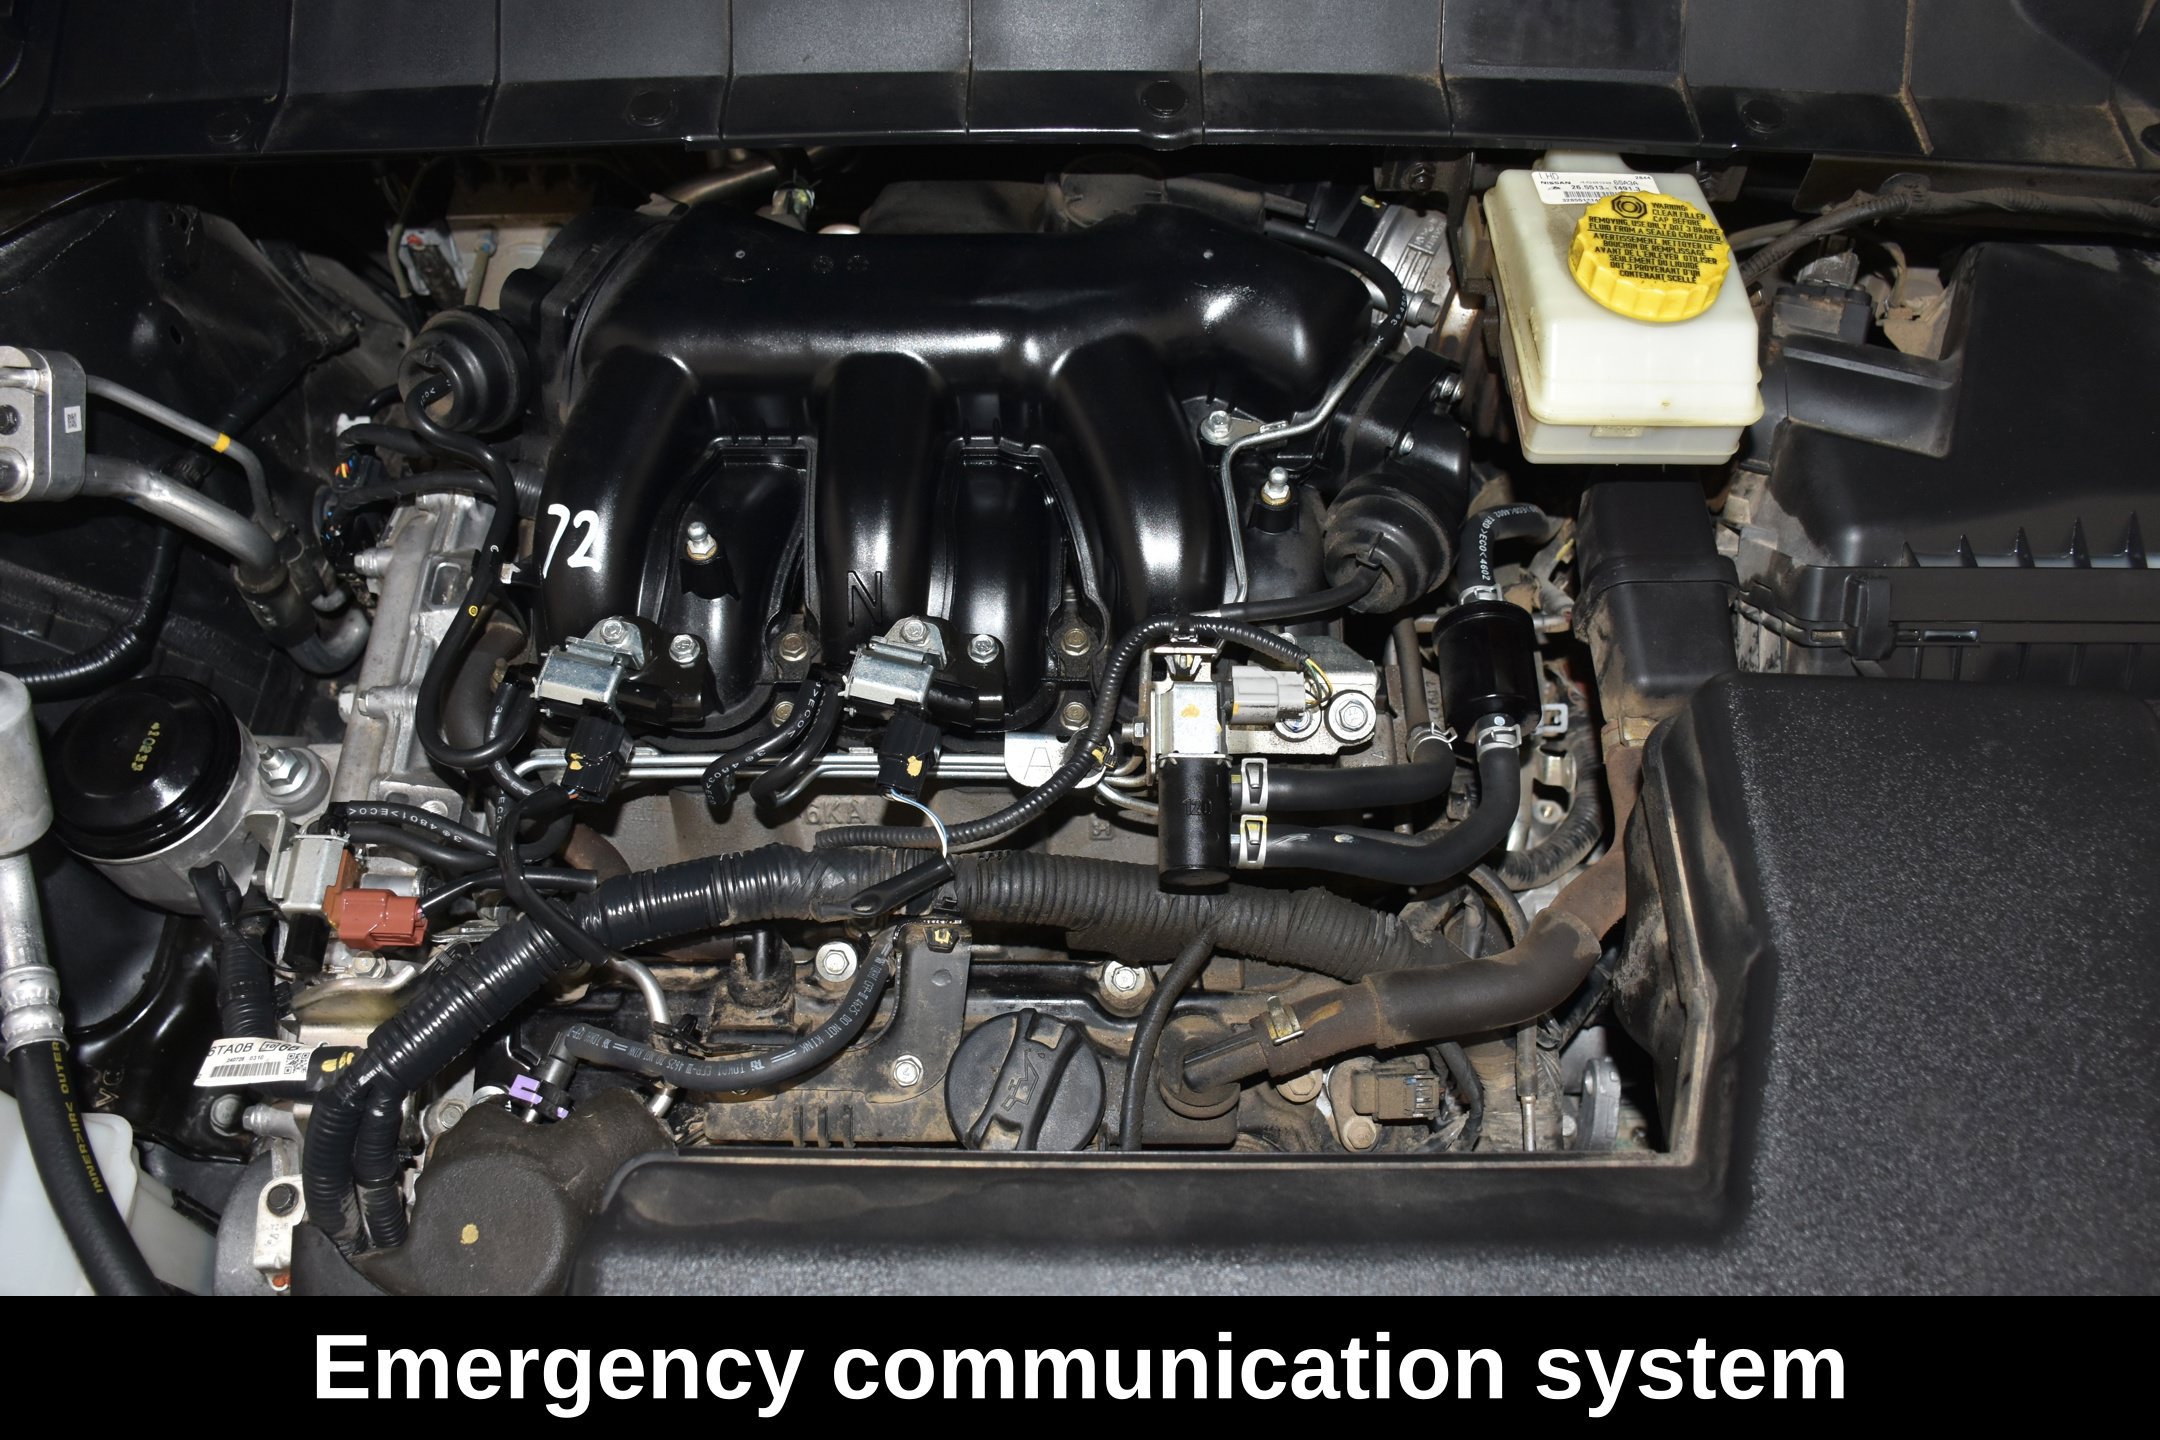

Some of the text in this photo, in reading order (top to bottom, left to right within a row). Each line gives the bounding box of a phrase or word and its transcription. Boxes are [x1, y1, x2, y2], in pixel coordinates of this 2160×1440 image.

[1651, 202, 1688, 212] WARNING:
[1652, 209, 1706, 220] CLEAN FILLER
[1647, 221, 1667, 230] ONLY
[1693, 226, 1719, 235] BRAKE
[1672, 218, 1701, 226] BEFORE
[1589, 223, 1612, 231] FLUID
[1614, 225, 1636, 233] FROM
[1646, 228, 1677, 237] SEALED
[1679, 231, 1721, 242] CONTAINER
[1595, 246, 1621, 255] AVANT
[1603, 240, 1638, 250] BOUCHON
[1651, 245, 1705, 256] REMPLISSAGE
[1662, 240, 1702, 250] NETTOYER
[1609, 255, 1655, 266] SEULEMENT
[1670, 260, 1699, 270] LIQUIDE
[1634, 264, 1681, 275] PROVENANT
[543, 503, 601, 580] 72
[1480, 558, 1491, 581] 4602
[847, 570, 883, 627] N
[848, 998, 865, 1016] 4625
[840, 1014, 853, 1026] DO
[825, 1023, 842, 1039] NOT
[799, 1034, 825, 1054] KINK
[51, 1040, 70, 1095] OUTER
[665, 1058, 685, 1072] 4625
